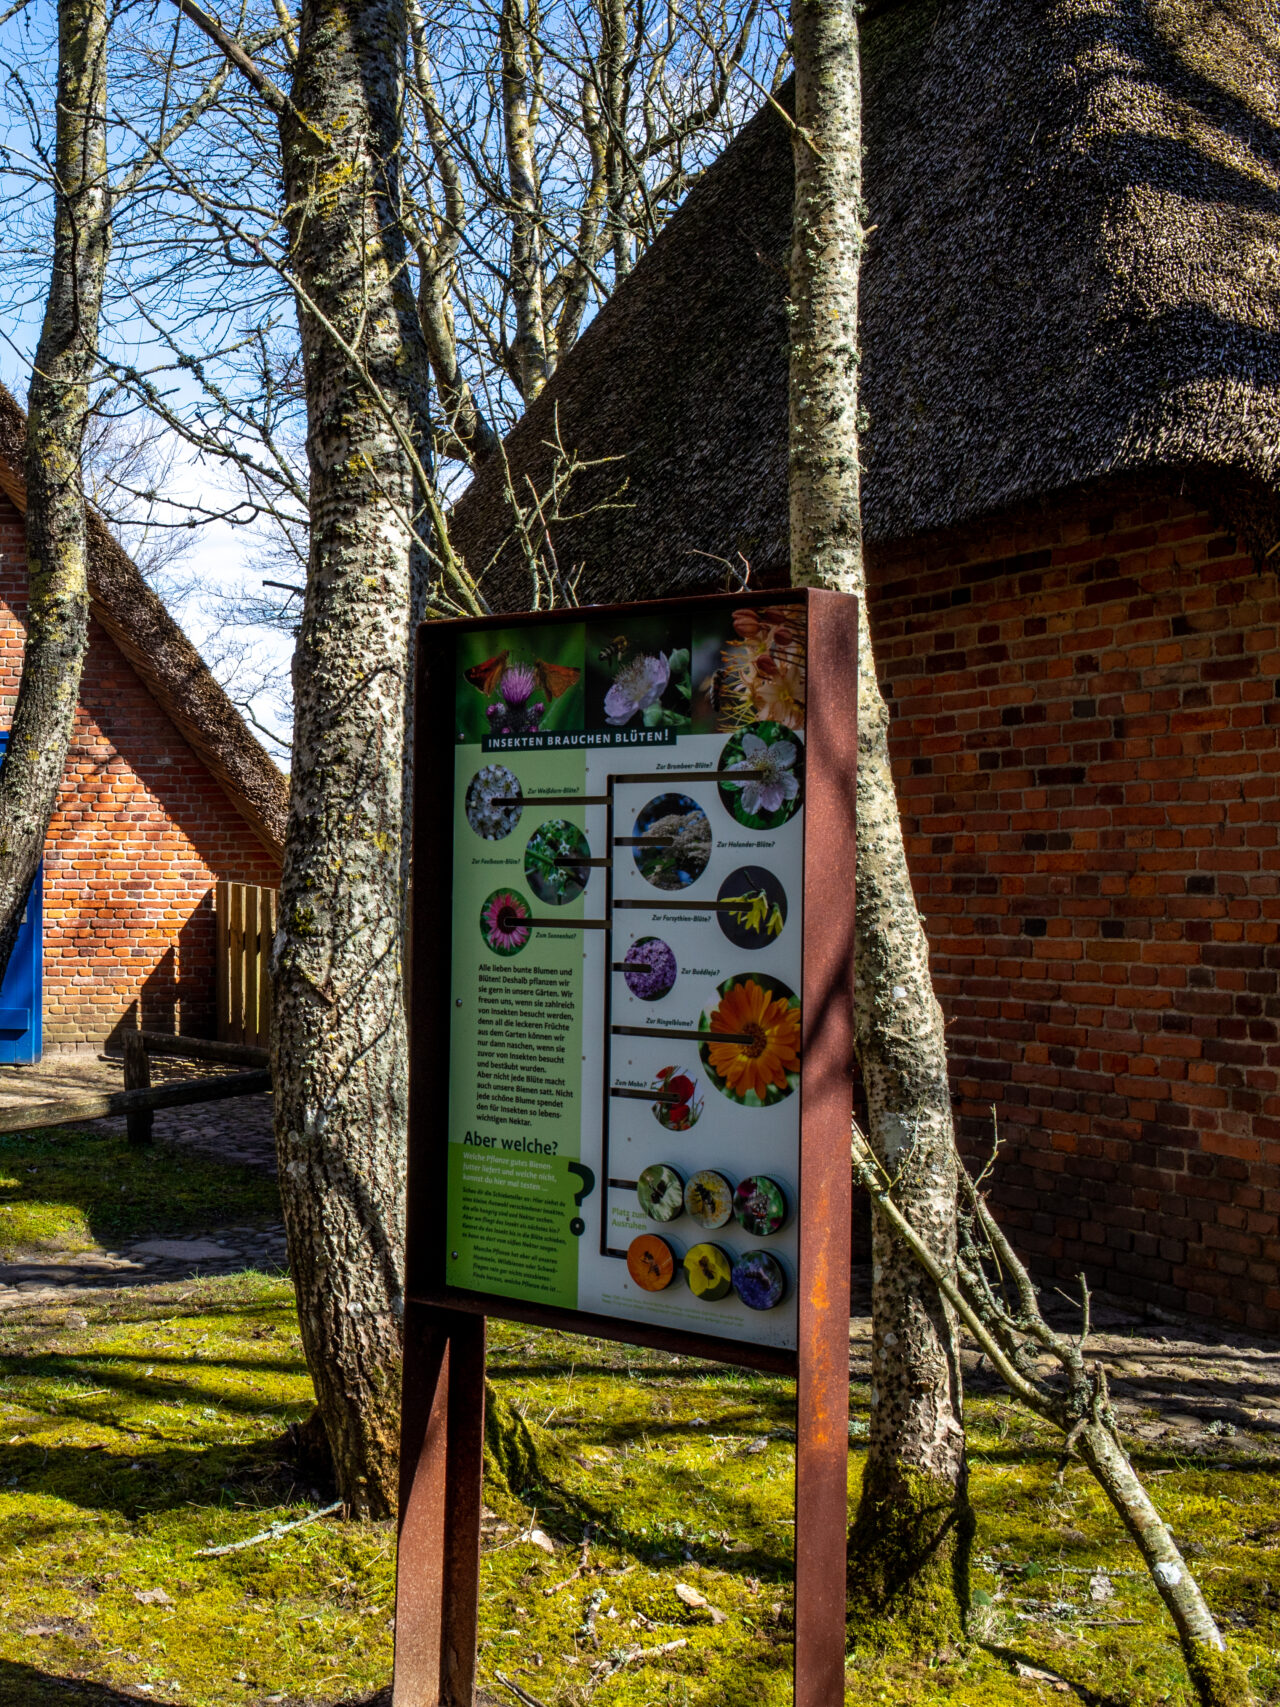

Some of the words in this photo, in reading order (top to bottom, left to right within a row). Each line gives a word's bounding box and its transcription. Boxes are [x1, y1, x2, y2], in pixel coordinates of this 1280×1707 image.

[488, 737, 543, 748] INSEKTEN
[547, 734, 610, 745] BRAUCHEN
[615, 729, 669, 742] BLÜTEN!
[529, 977, 557, 986] pflanzen
[545, 1001, 574, 1009] zahlreich
[520, 1010, 544, 1018] besucht
[547, 1012, 573, 1021] werden,
[516, 1020, 543, 1029] leckeren
[544, 1022, 569, 1031] Früchte
[505, 1030, 526, 1038] Garten
[507, 1042, 534, 1051] naschen,
[510, 1053, 537, 1061] Insekten
[539, 1055, 564, 1063] besucht
[491, 1061, 518, 1070] bestäubt
[494, 1072, 510, 1080] nicht
[511, 1074, 524, 1082] jede
[516, 1085, 538, 1094] Bienen
[492, 1094, 514, 1102] schöne
[515, 1096, 535, 1105] Blume
[537, 1099, 563, 1108] spendet
[501, 1105, 528, 1114] Insekten
[539, 1109, 562, 1119] lebens-
[476, 1114, 507, 1124] wichtigen
[509, 1117, 532, 1126] Nektar.
[463, 1130, 497, 1149] Aber
[501, 1136, 558, 1155] welche?
[463, 1152, 485, 1161] Welche
[487, 1155, 509, 1165] Pflanze
[529, 1160, 552, 1170] Bienen-
[463, 1162, 481, 1171] futter
[482, 1165, 500, 1174] liefert
[516, 1169, 537, 1179] welche
[539, 1172, 557, 1183] nicht,
[520, 1182, 540, 1190] testen
[612, 1208, 629, 1216] Platz
[612, 1219, 647, 1230] Ausruhen
